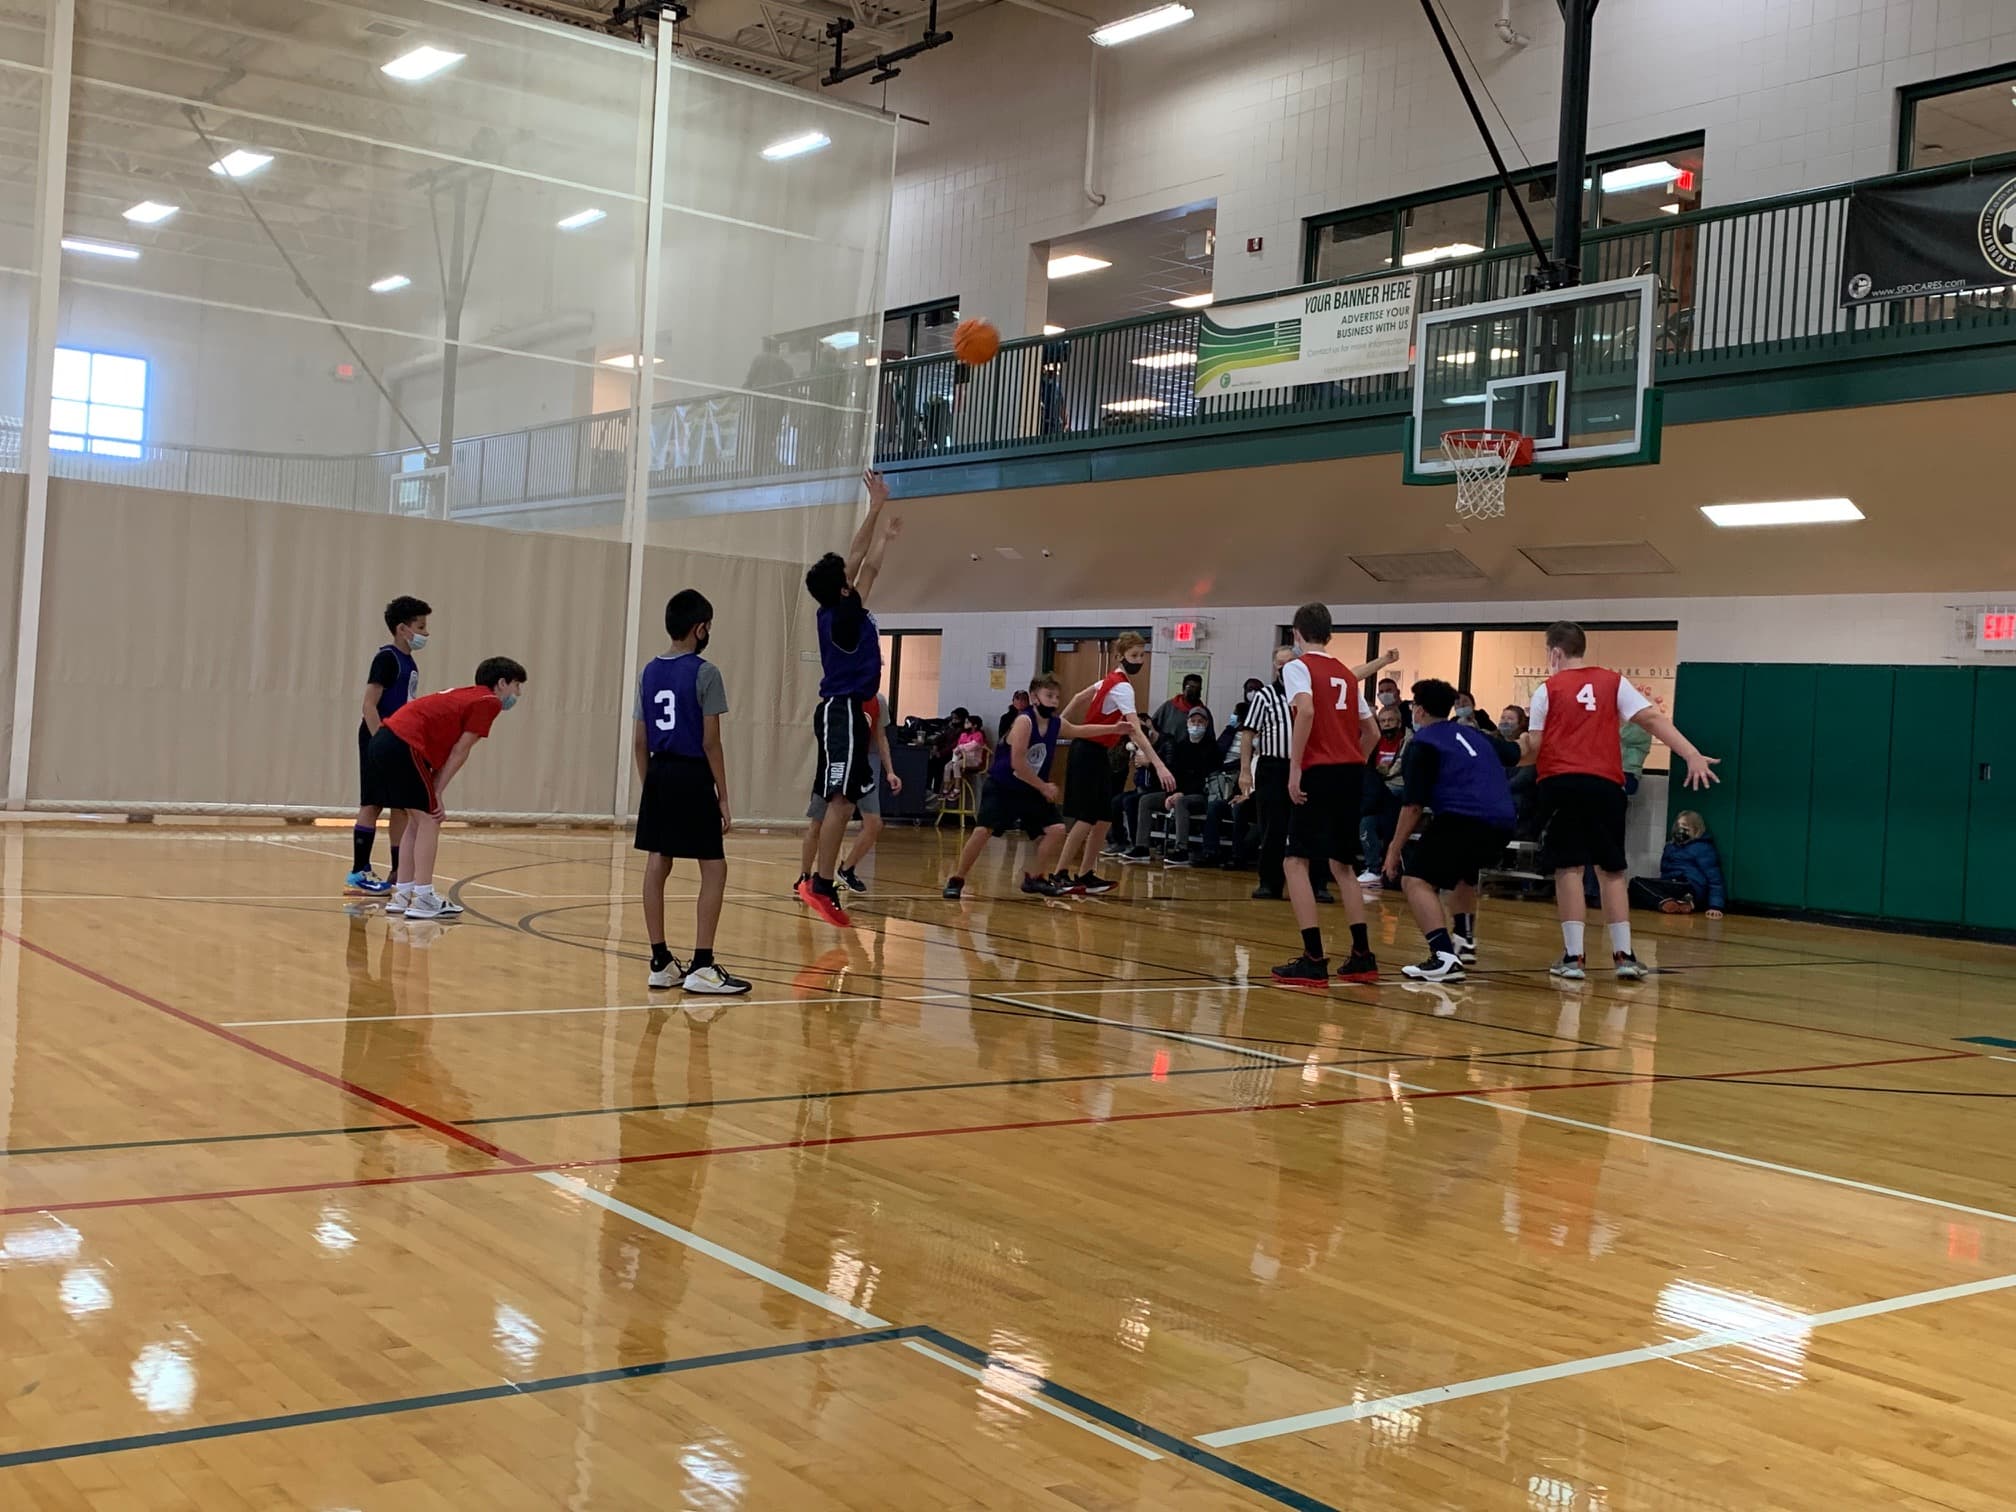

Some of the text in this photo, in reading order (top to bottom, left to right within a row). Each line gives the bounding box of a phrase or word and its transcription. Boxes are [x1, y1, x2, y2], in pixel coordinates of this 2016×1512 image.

[1983, 235, 2008, 267] INDOOR
[1305, 280, 1412, 314] YOUR BANNER HERE
[1871, 279, 1966, 296] www.SPDCARES.com
[1341, 305, 1410, 325] ADVERTISE YOUR
[1337, 320, 1409, 338] BUSINESS WITH US
[1515, 665, 1672, 677] STREA ARK DIS
[1329, 676, 1348, 711] 7
[1576, 683, 1597, 711] 4
[654, 689, 676, 731] 3
[1457, 732, 1478, 757] 1
[830, 761, 846, 779] NBA
